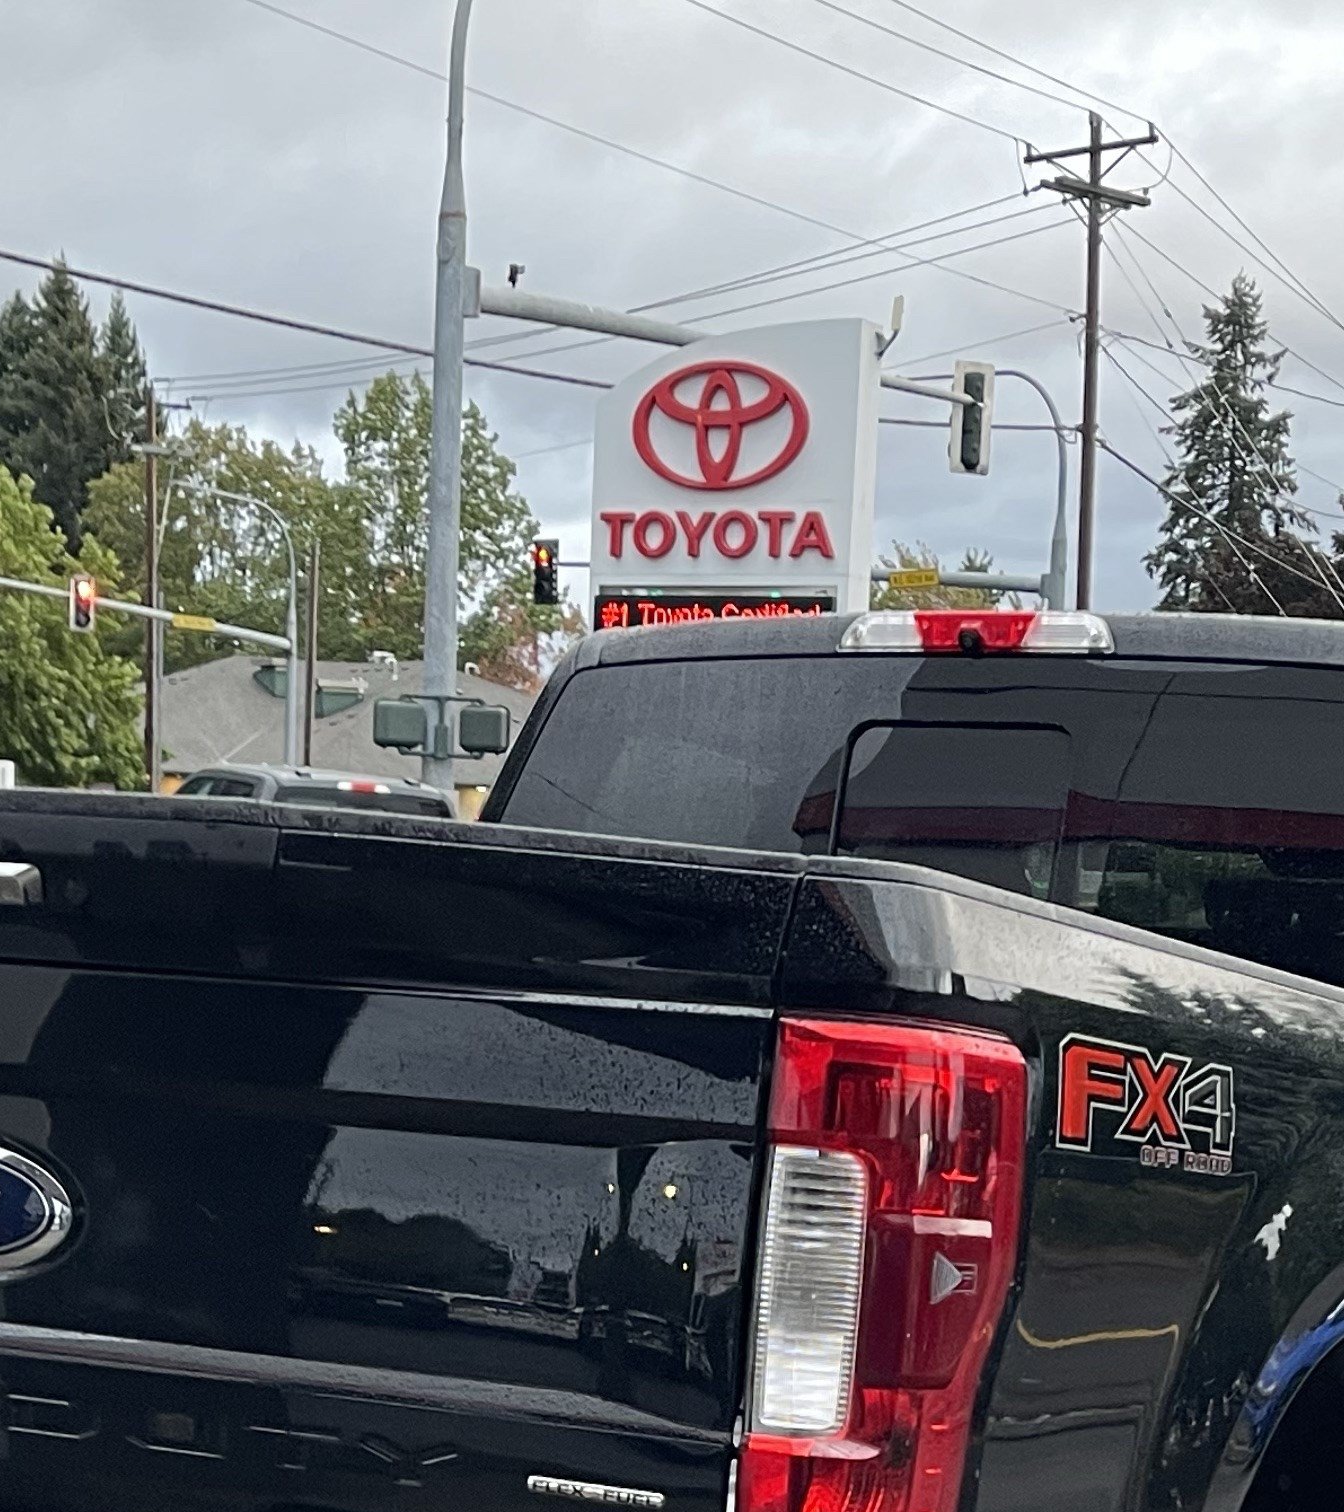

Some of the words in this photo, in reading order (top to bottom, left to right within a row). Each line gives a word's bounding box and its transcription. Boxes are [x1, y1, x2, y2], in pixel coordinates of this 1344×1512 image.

[600, 510, 834, 558] TOYOTA
[602, 602, 629, 628] #1
[1056, 1032, 1235, 1156] FX4
[1140, 1144, 1179, 1168] OFF
[1184, 1151, 1232, 1176] ROAD
[6, 1392, 459, 1488] DUTY
